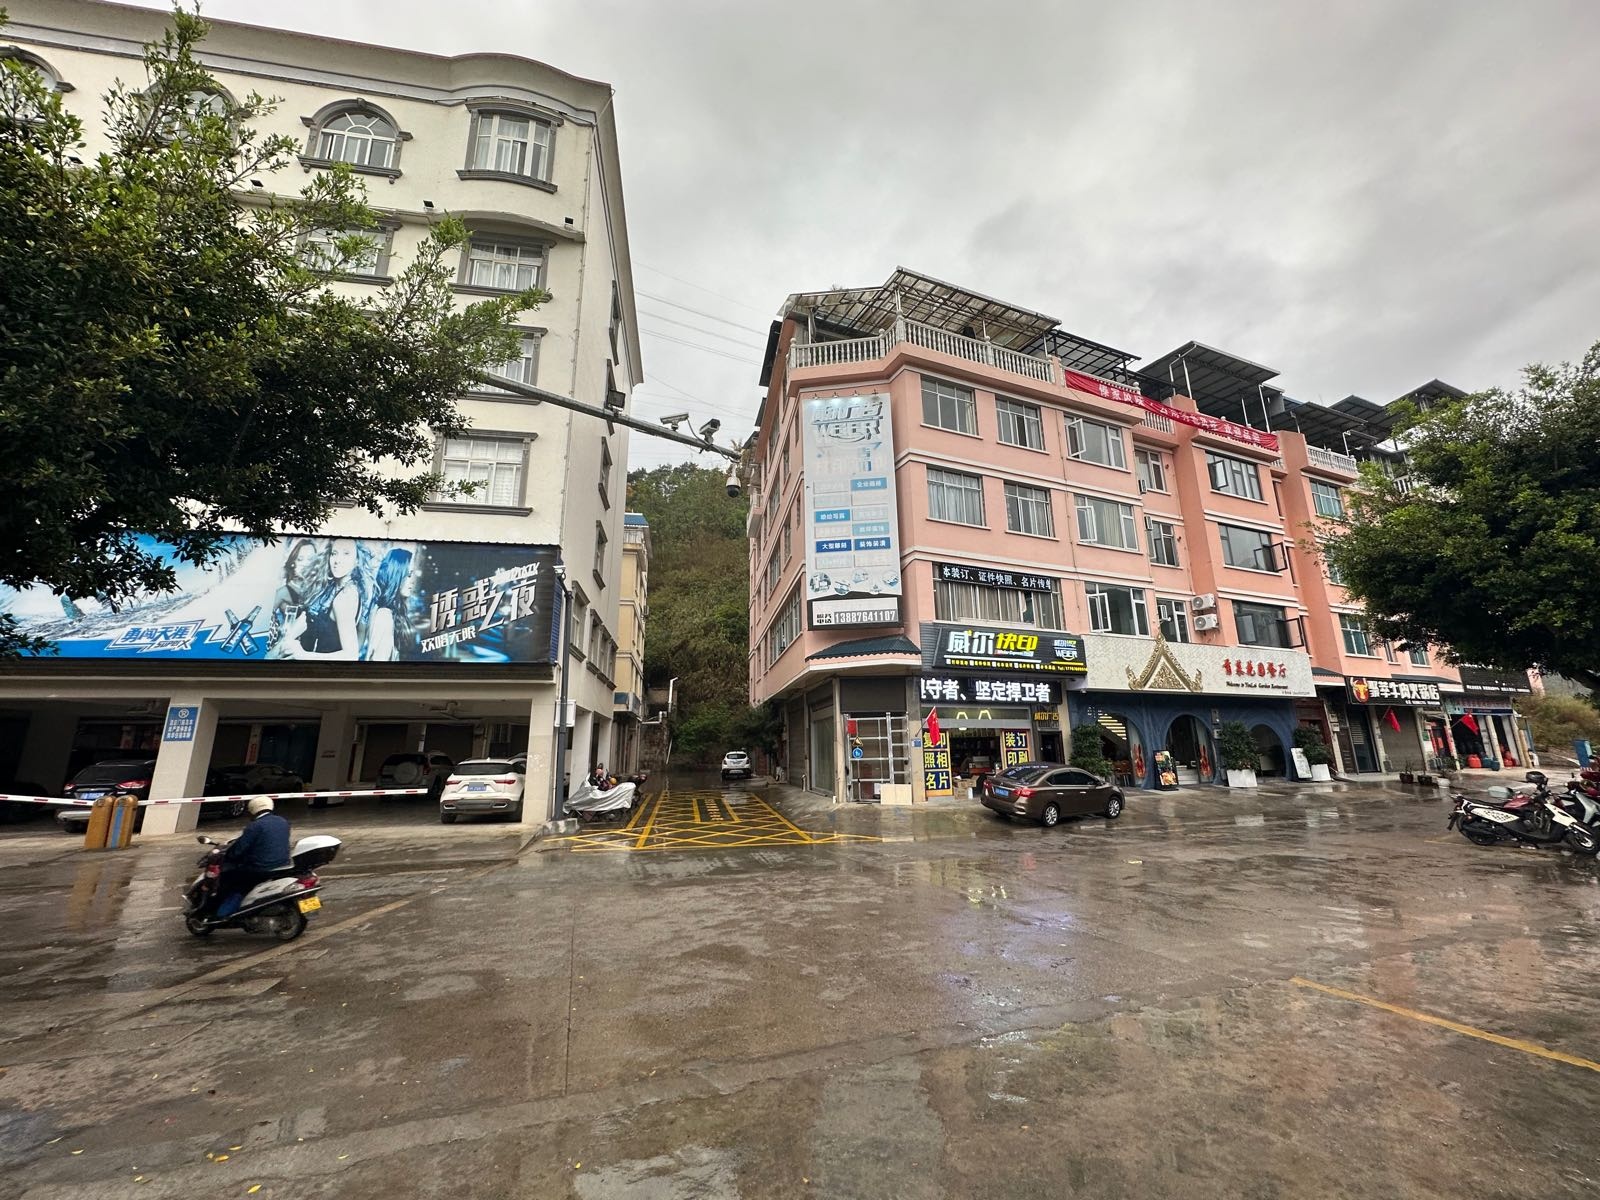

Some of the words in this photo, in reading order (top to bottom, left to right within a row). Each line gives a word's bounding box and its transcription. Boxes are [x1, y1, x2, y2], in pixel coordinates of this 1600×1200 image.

[429, 578, 538, 634] 诱惑之夜
[835, 609, 897, 624] 13887641107
[121, 626, 190, 643] 勇闯天涯
[421, 625, 477, 653] 欢唱无限
[947, 630, 1039, 655] 威尔快印
[1005, 732, 1027, 747] 装订
[924, 752, 948, 769] 照相
[926, 772, 949, 790] 名片
